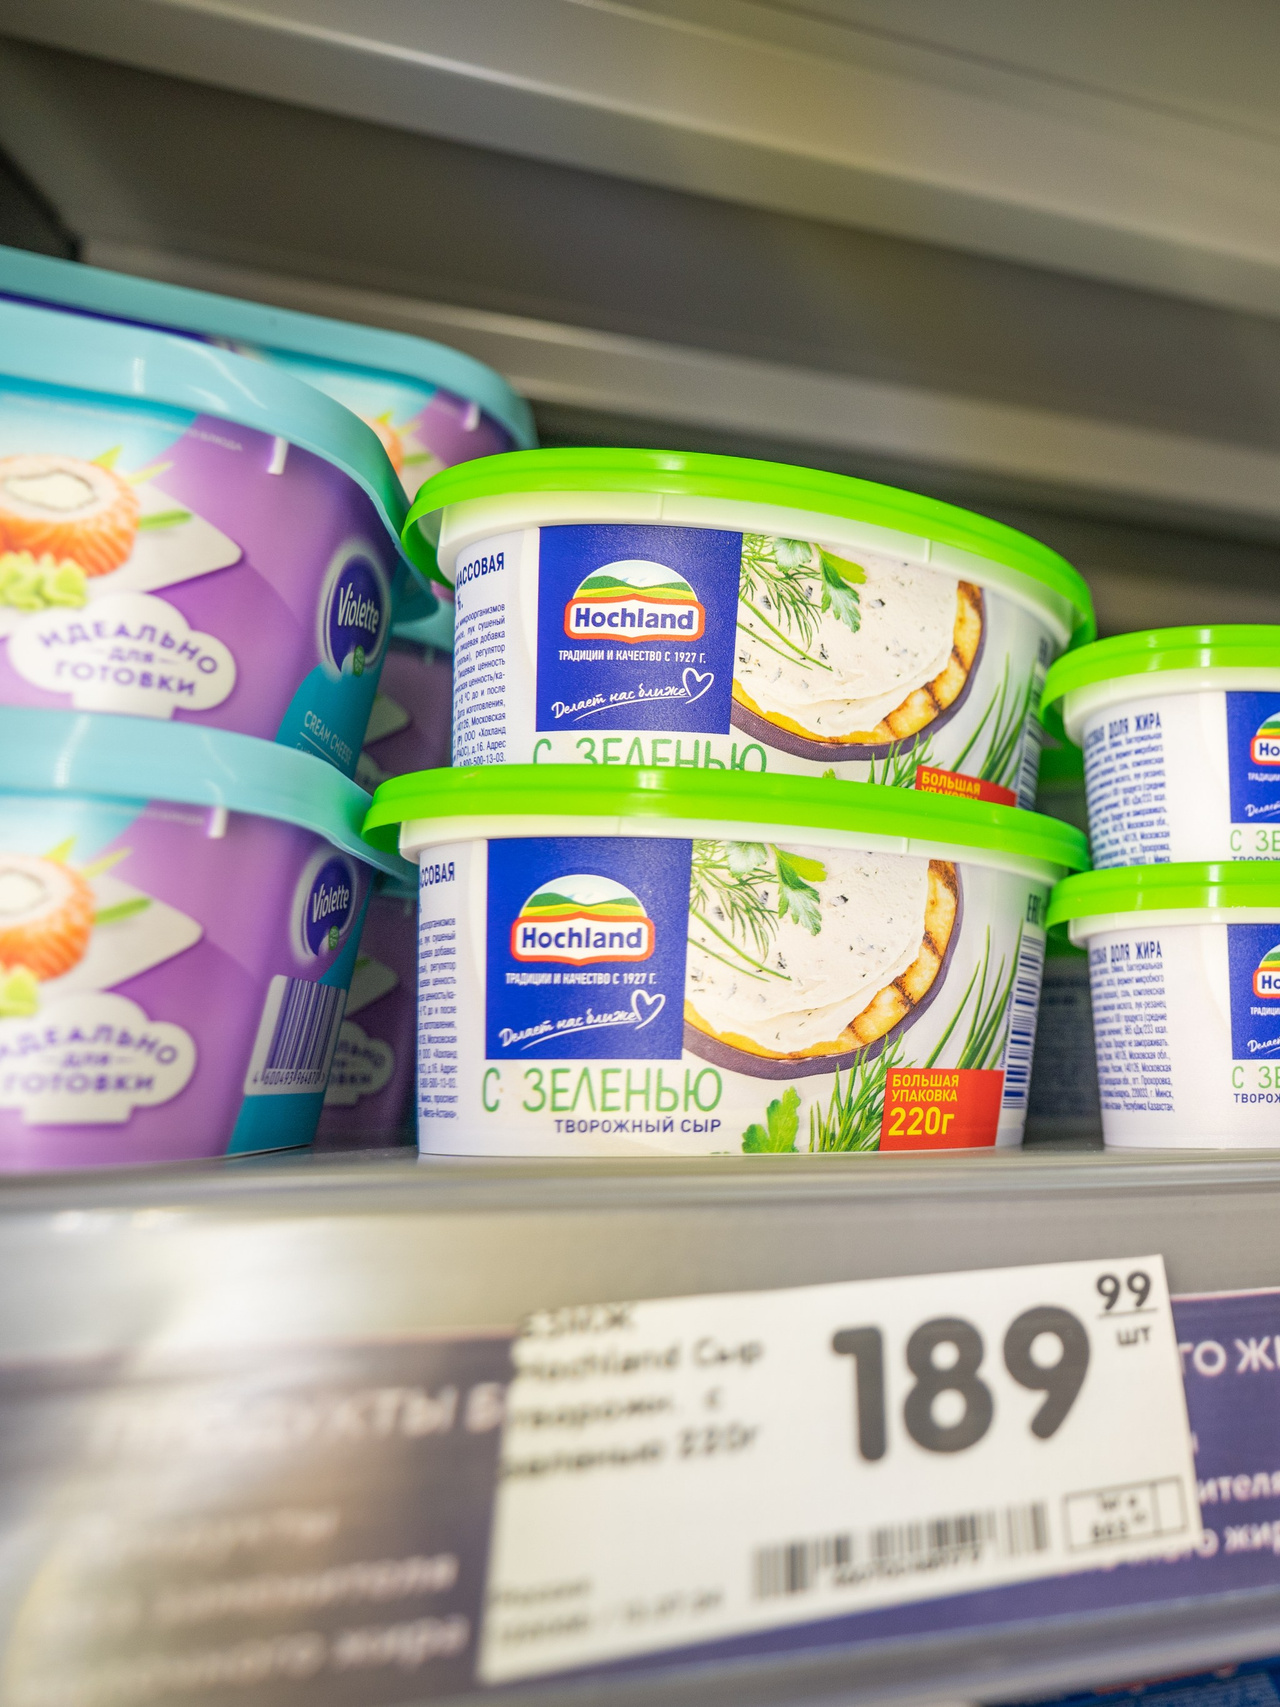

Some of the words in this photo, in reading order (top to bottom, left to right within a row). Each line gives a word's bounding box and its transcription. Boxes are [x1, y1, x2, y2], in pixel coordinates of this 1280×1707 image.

[337, 582, 380, 634] Violette
[575, 607, 694, 630] Hochland
[40, 623, 218, 674] ИДЕАЛЬНО
[559, 649, 604, 662] ТРАДИЦИИ
[607, 650, 613, 660] И
[616, 651, 661, 662] КАЧЕСТВО
[665, 652, 670, 661] С
[675, 652, 696, 663] 1927
[54, 660, 195, 697] ГОТОВКИ
[551, 693, 606, 718] Делает
[610, 690, 635, 703] нас
[638, 683, 687, 698] ближе
[304, 710, 331, 745] CREAM
[1135, 712, 1161, 732] ЖИРА
[532, 738, 552, 766] С
[575, 736, 768, 773] ЗЕЛЕНЬЮ
[921, 771, 981, 796] БОЛЬШАЯ
[1230, 829, 1242, 852] С
[313, 884, 350, 924] Violette
[521, 927, 643, 949] Hochland
[1135, 940, 1163, 960] ЖИРА
[506, 972, 551, 985] ТРАДИЦИИ
[562, 973, 610, 985] КАЧЕСТВО
[623, 973, 646, 984] 1927
[499, 1020, 553, 1047] Делает
[556, 1016, 584, 1029] нас
[586, 1009, 637, 1024] ближе
[482, 1066, 500, 1112] С
[523, 1066, 723, 1113] ЗЕЛЕНЬЮ
[892, 1074, 959, 1087] БОЛЬШАЯ
[1232, 1066, 1244, 1089] С
[891, 1089, 958, 1102] УПАКОВКА
[555, 1116, 674, 1133] ТВОРОЖНЫЙ
[681, 1119, 721, 1133] СЫР
[888, 1106, 955, 1136] 220г
[1116, 1324, 1153, 1348] шт
[832, 1304, 1091, 1462] 189
[1095, 1270, 1152, 1312] 99
